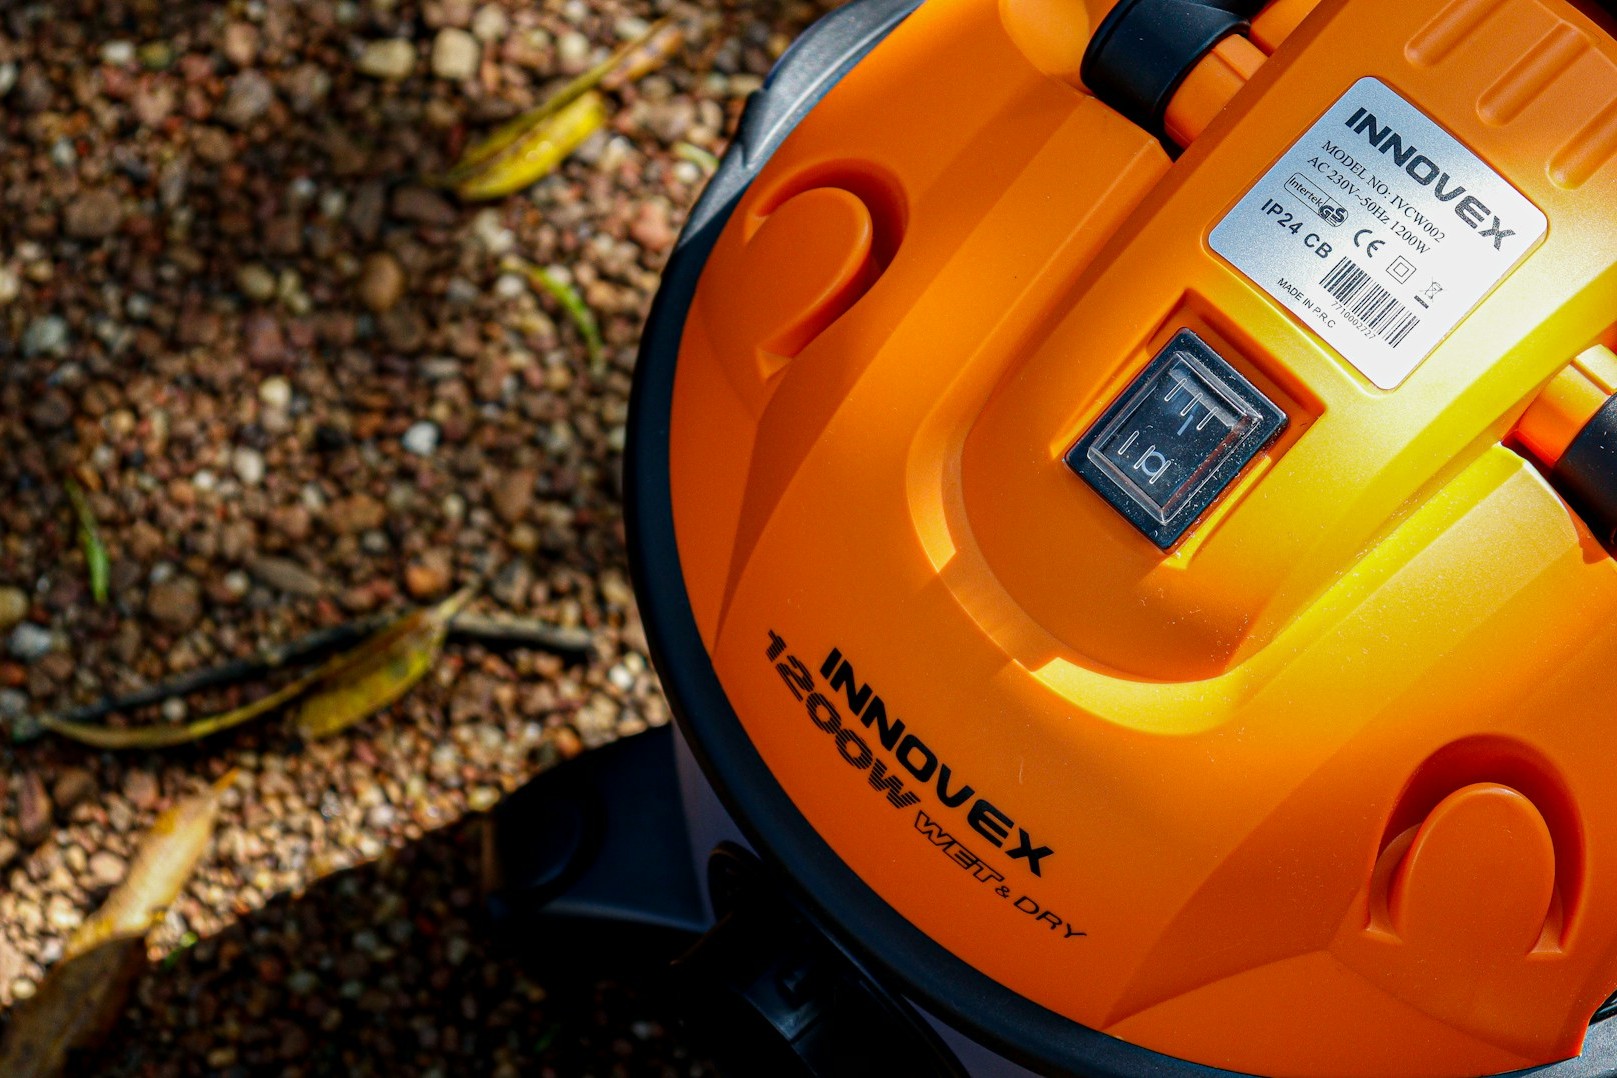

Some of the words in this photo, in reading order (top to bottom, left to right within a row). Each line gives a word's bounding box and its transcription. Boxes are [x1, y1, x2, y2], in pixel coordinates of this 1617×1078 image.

[1287, 177, 1323, 208] Intertek
[1318, 204, 1347, 223] GS
[1307, 156, 1330, 174] AC
[1390, 220, 1431, 255] 1200W
[1321, 139, 1367, 180] MODEL
[1366, 174, 1391, 200] NO:
[1390, 194, 1446, 243] IVCW002
[1344, 106, 1517, 252] INNOVEX
[1261, 198, 1304, 235] IP24
[1303, 232, 1333, 259] CB
[1353, 228, 1386, 258] CE
[1277, 277, 1305, 301] MADE
[1302, 297, 1316, 309] IN
[1331, 300, 1376, 340] 7710002727
[765, 629, 921, 810] 1200W
[913, 809, 1006, 884] WET
[994, 884, 1011, 899] &
[1013, 895, 1088, 939] DRY
[819, 647, 1055, 878] INNOVEX
